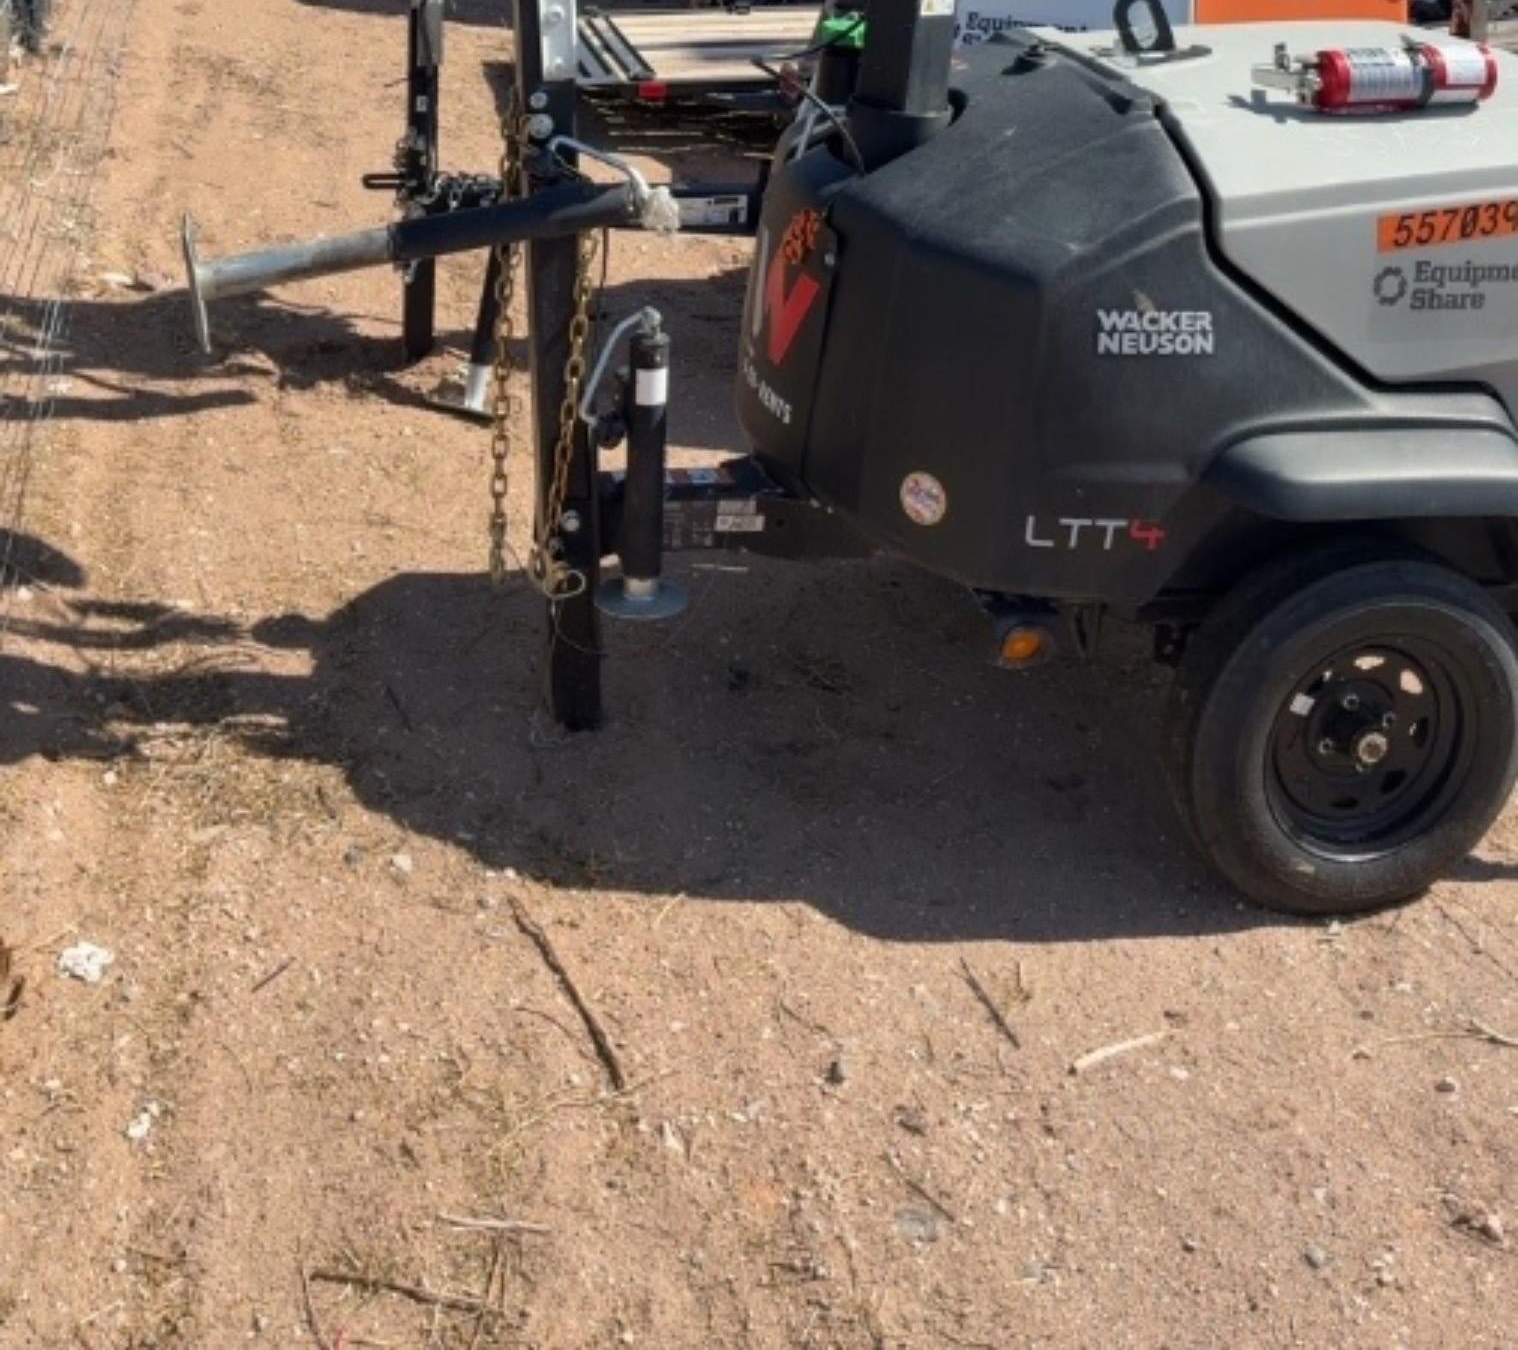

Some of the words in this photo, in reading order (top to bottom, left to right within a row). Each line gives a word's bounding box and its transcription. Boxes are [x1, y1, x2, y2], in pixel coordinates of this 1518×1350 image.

[1409, 287, 1486, 310] Share
[1097, 309, 1214, 331] WACKER
[1097, 332, 1214, 355] NEUSON
[1025, 514, 1165, 550] LTT4
